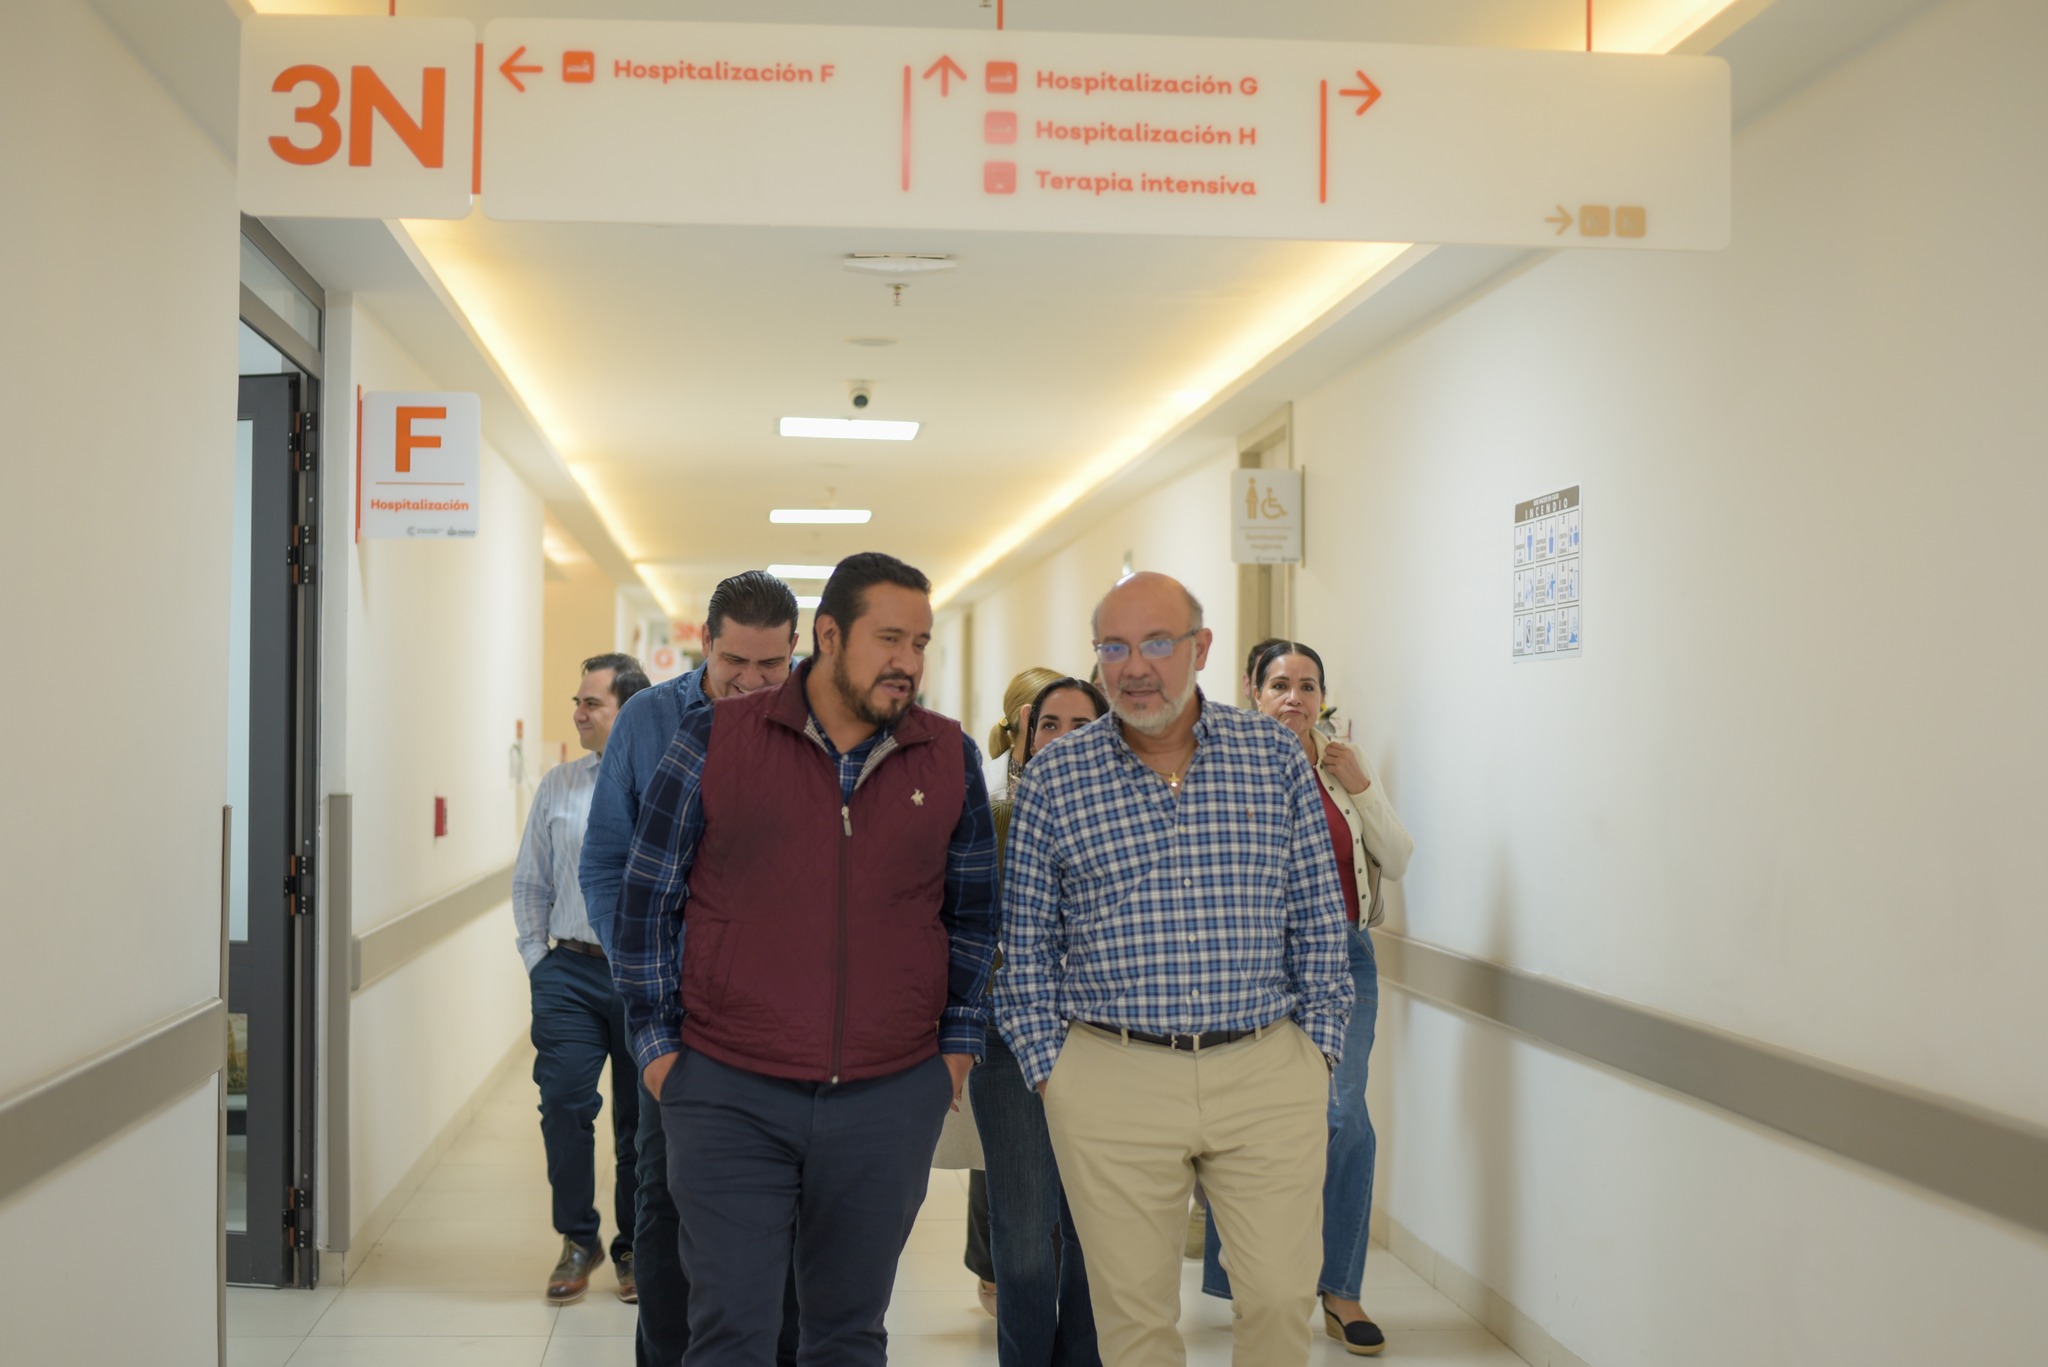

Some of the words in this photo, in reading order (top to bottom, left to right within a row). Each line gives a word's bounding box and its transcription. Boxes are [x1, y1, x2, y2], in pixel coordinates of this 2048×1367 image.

[613, 58, 814, 85] Hospitalización
[819, 63, 835, 83] F
[1035, 70, 1234, 97] Hospitalización
[1238, 77, 1260, 96] G
[268, 64, 446, 169] 3N
[1035, 120, 1233, 147] Hospitalización
[1237, 127, 1257, 145] H
[1036, 169, 1134, 196] Terapia
[1140, 173, 1257, 197] intensiva
[395, 406, 447, 473] F
[371, 499, 469, 513] Hospitalización
[1524, 497, 1569, 520] INCENDIO
